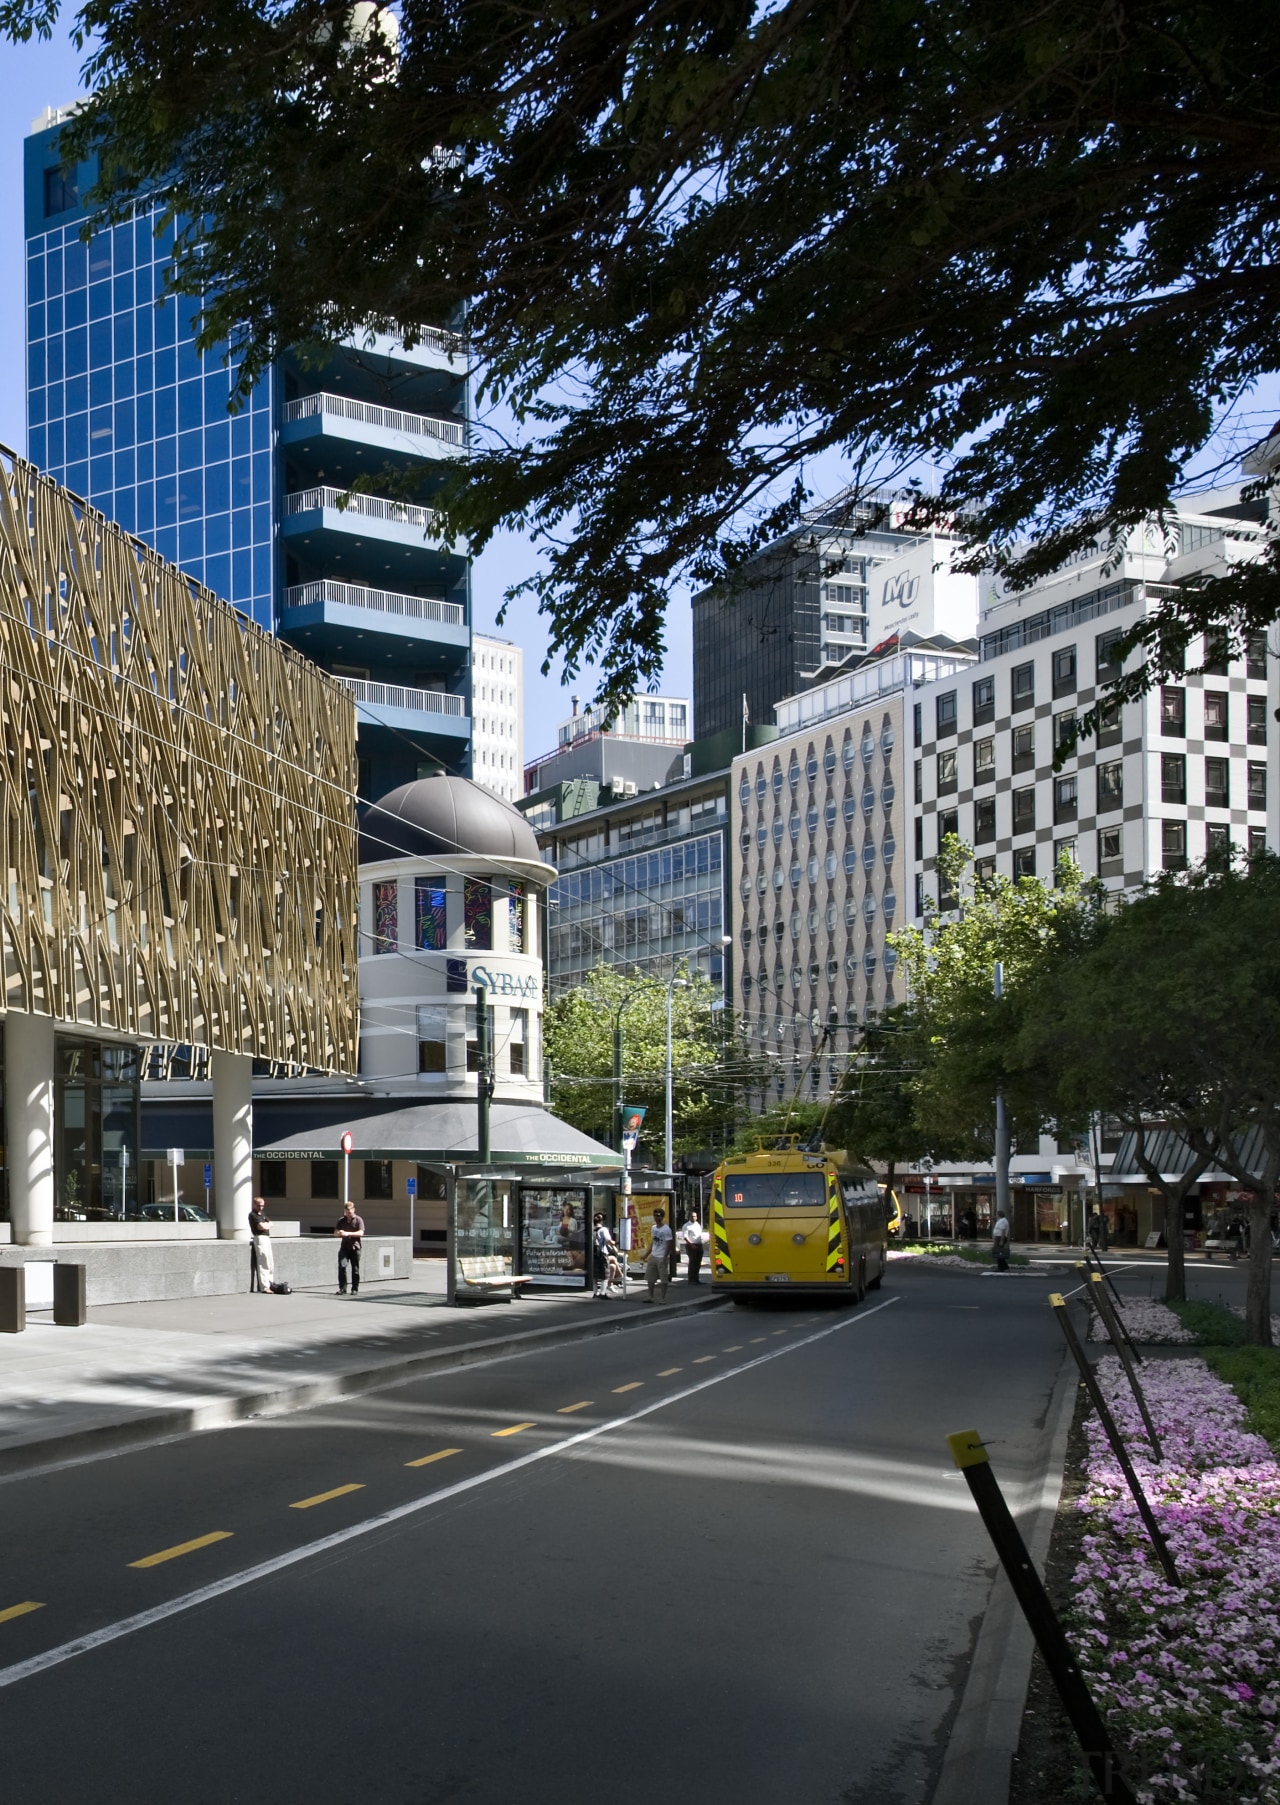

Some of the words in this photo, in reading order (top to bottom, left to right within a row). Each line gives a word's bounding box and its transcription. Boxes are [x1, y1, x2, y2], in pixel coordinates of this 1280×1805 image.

[882, 569, 920, 608] MU
[471, 966, 537, 999] SYBASE
[266, 1151, 325, 1159] OCCIDENTAL
[539, 1153, 591, 1163] OCCIDENTAL
[734, 1193, 743, 1202] 10
